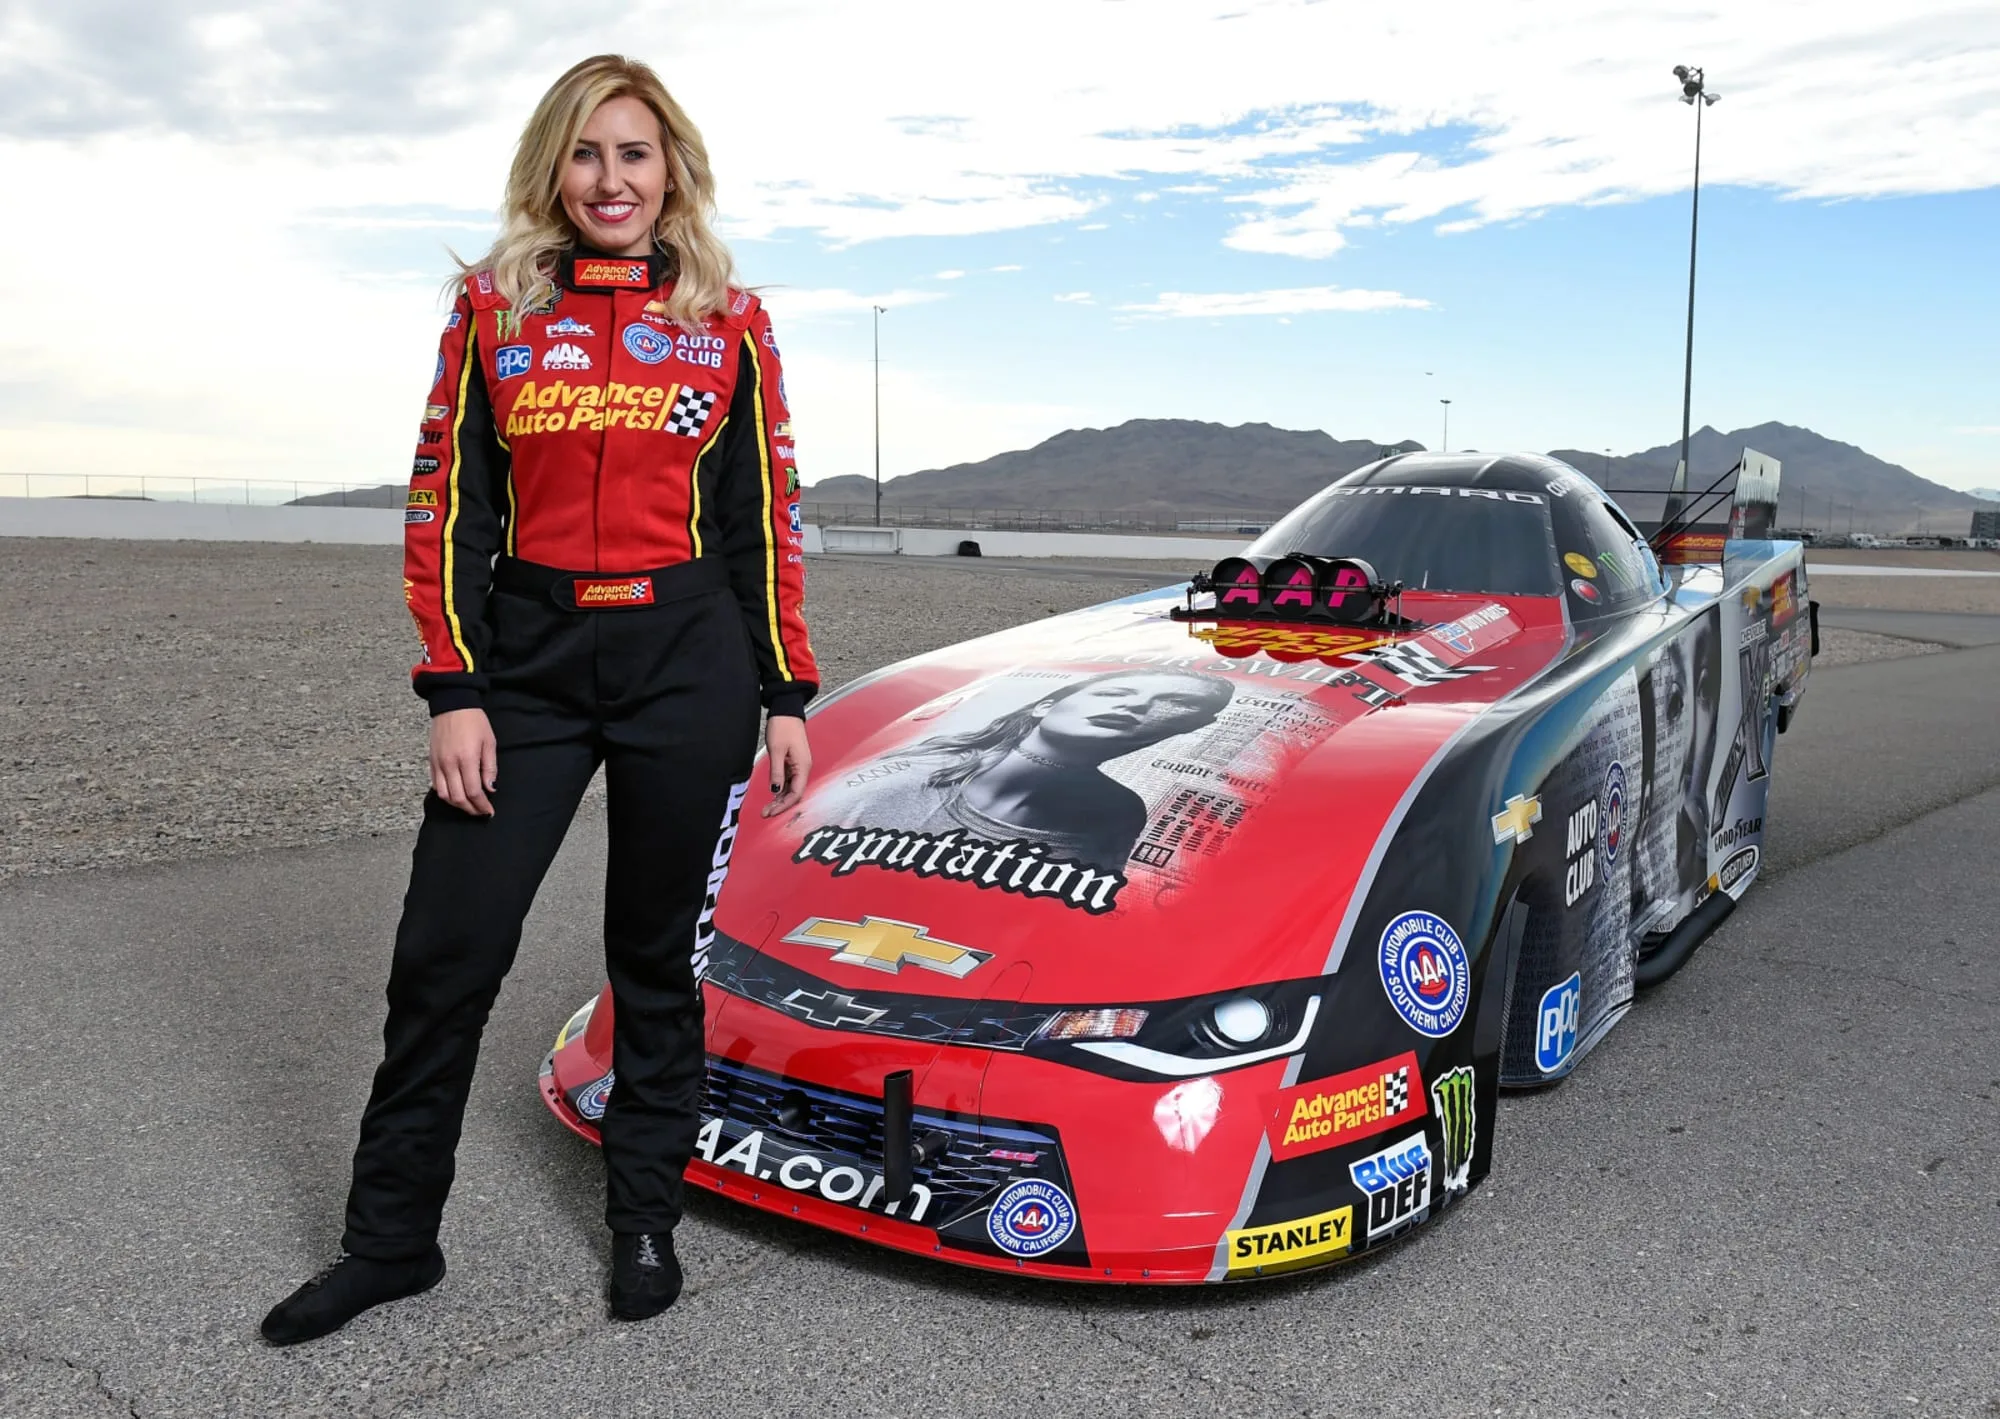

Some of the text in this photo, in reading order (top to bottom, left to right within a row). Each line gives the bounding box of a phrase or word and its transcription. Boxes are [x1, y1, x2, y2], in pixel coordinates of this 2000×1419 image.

[586, 264, 627, 273] Advance
[546, 324, 595, 335] PEAK
[676, 334, 725, 350] AUTO
[498, 350, 529, 376] PPG
[542, 361, 592, 370] TOOLS
[543, 343, 591, 363] MAC
[676, 348, 722, 368] CLUB
[512, 380, 664, 411] Advance
[505, 406, 655, 437] Auto Parts
[580, 593, 602, 601] Auto
[587, 585, 630, 594] Advance
[1168, 788, 1198, 815] Taylor
[1146, 813, 1177, 842] Swift!
[1164, 793, 1215, 847] Taylor Swift!
[1182, 797, 1234, 852] Taylor Swift!
[1566, 799, 1597, 860] AUTO
[1715, 818, 1761, 852] GOODYEAR
[799, 829, 1118, 909] reputation
[1565, 848, 1595, 907] CLUB
[1385, 918, 1458, 968] AUTOMOBILE CLUB
[1409, 954, 1448, 985] AAA
[1389, 961, 1466, 1030] SOUTHERN CALIFORNIA
[1544, 988, 1579, 1058] PPG
[1290, 1081, 1379, 1124] Advance
[1282, 1103, 1380, 1147] Auto Parts
[1353, 1143, 1429, 1193] Blue
[1000, 1184, 1070, 1218] AUTOMOBILE CLUB
[1370, 1169, 1428, 1231] DEF
[992, 1214, 1070, 1251] SOUTHERN CALIFORNIA
[1012, 1210, 1049, 1227] AAA
[1236, 1216, 1347, 1258] STANLEY
